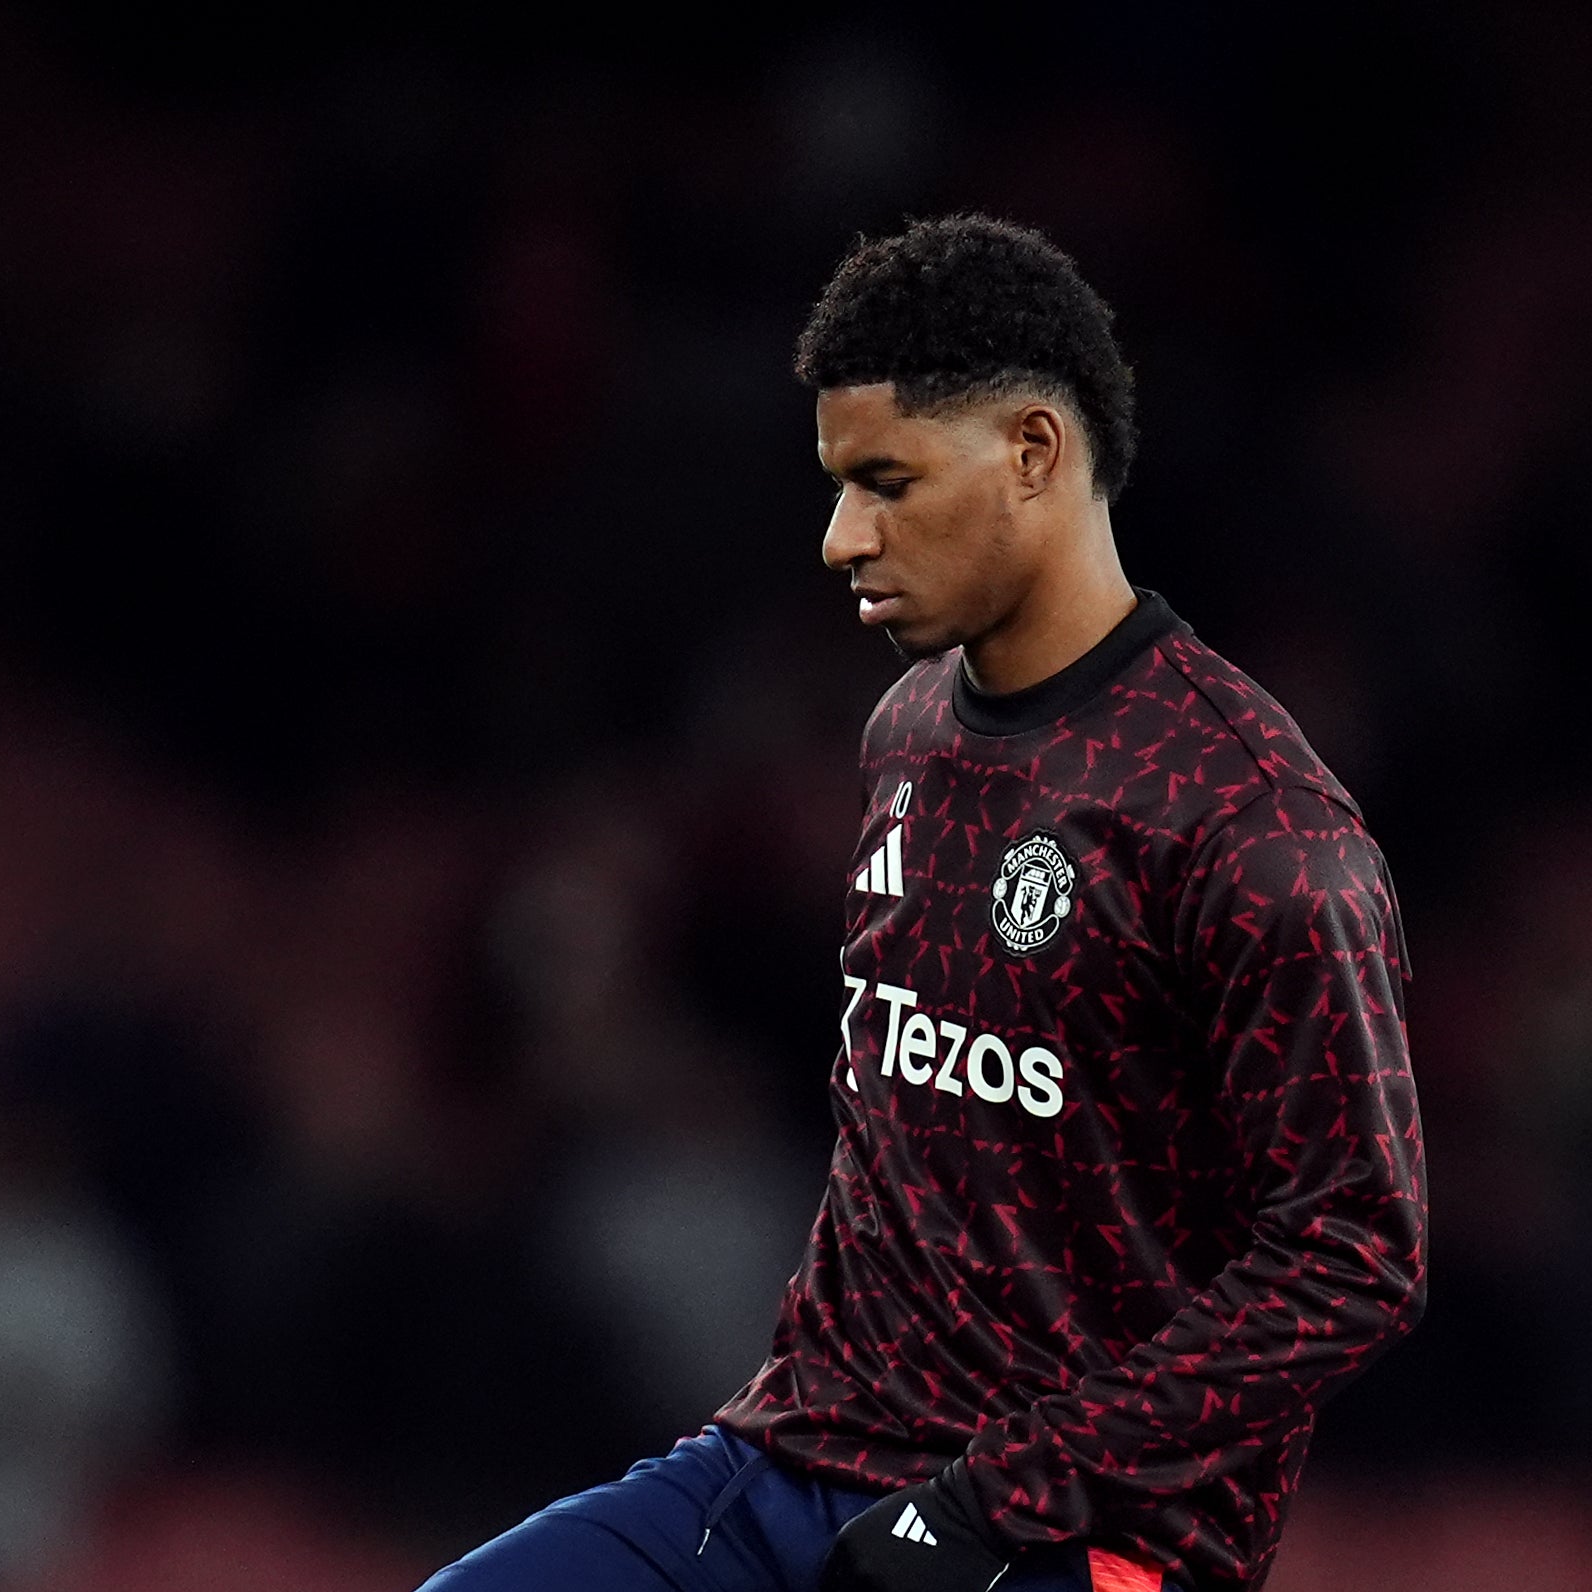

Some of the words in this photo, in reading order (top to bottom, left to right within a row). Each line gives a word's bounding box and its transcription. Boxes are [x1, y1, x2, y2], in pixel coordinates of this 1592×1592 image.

[890, 781, 912, 819] 10
[1007, 844, 1068, 889] MANCHESTER
[999, 917, 1044, 943] UNITED
[875, 982, 1064, 1118] Tezos
